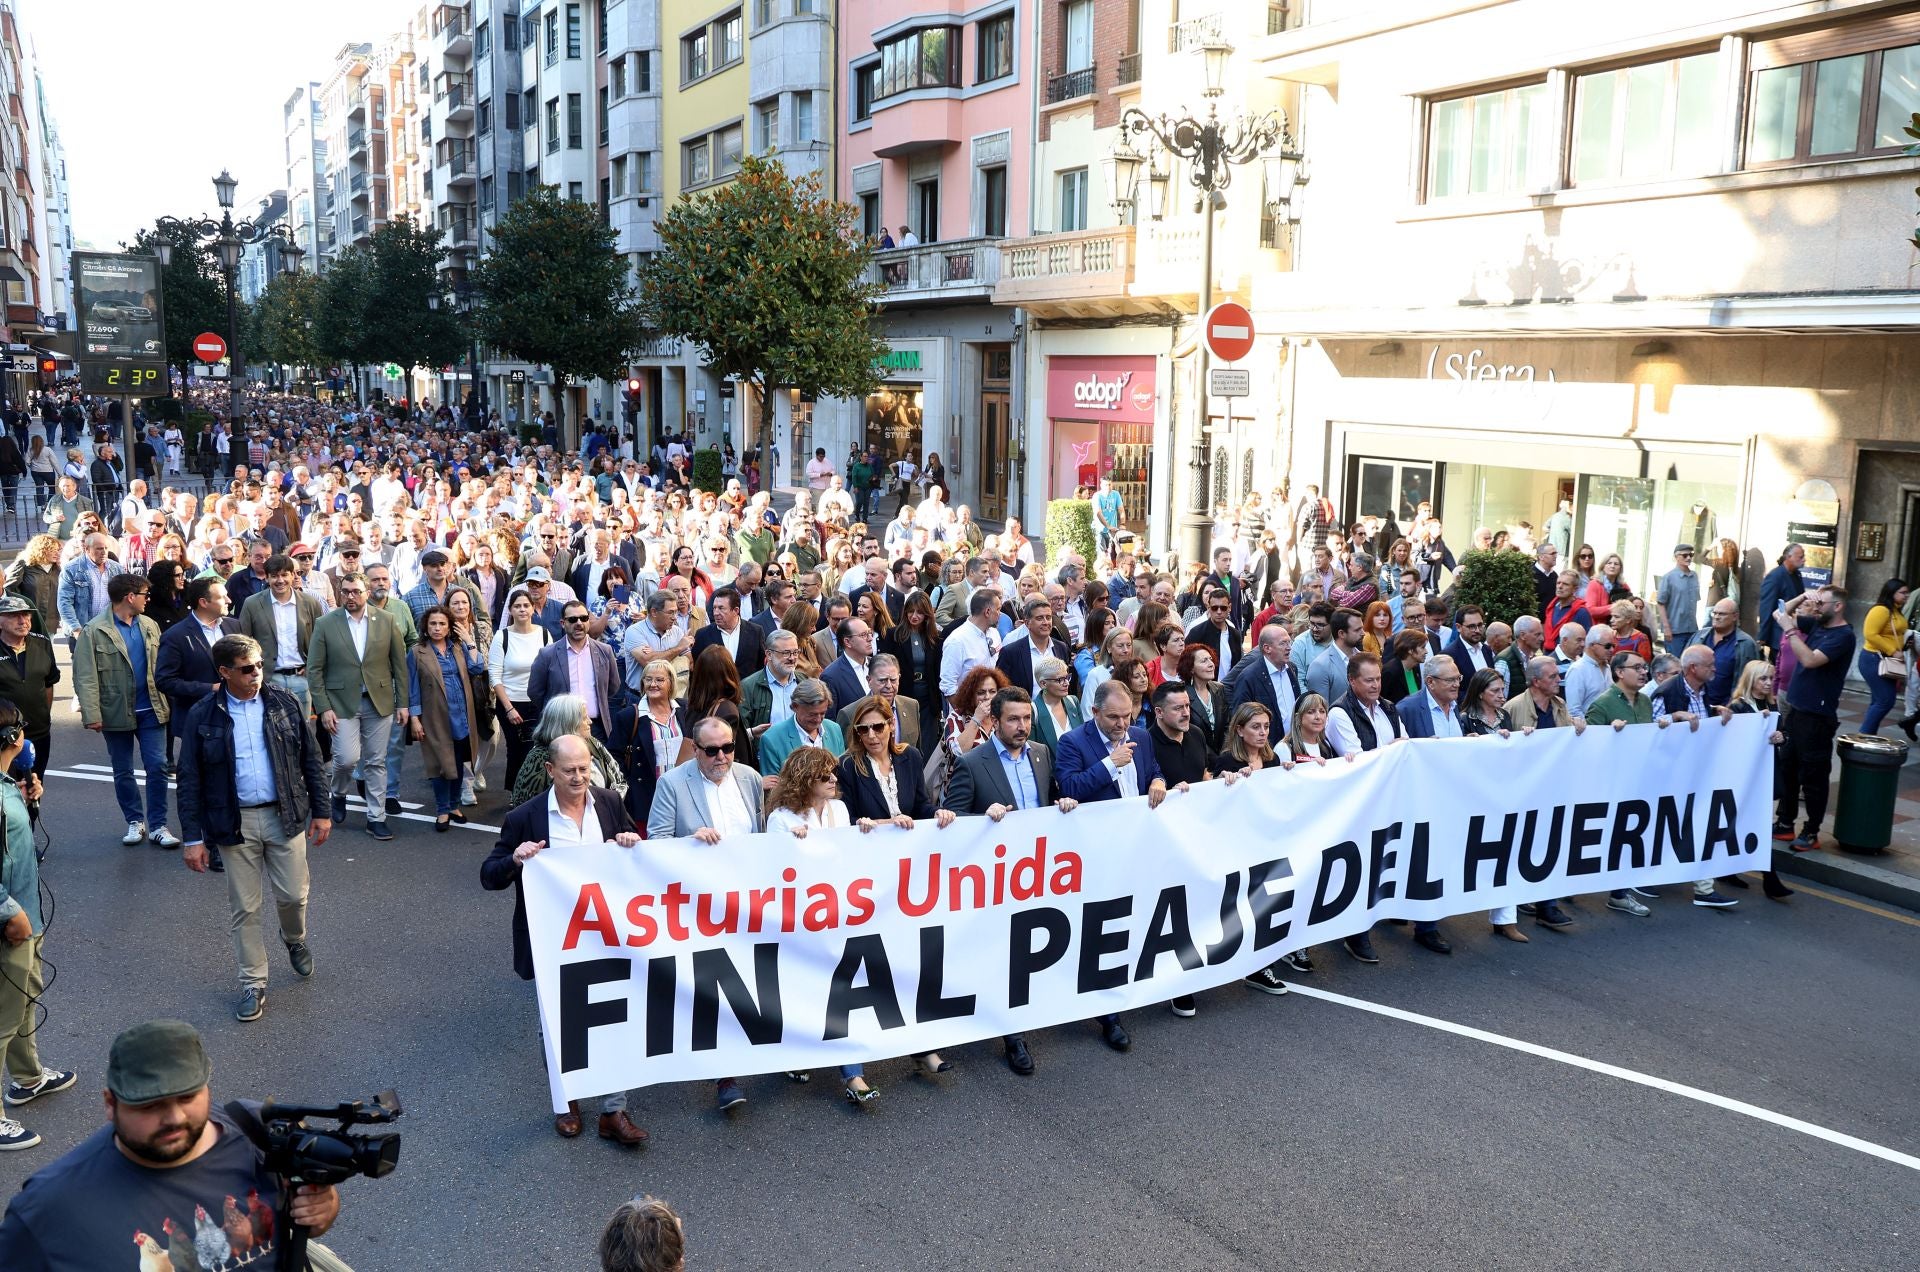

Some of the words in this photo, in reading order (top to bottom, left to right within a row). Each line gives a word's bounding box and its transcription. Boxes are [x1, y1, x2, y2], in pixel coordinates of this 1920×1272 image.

[559, 942, 783, 1074] FIN
[822, 925, 976, 1041] AL
[1008, 857, 1295, 1009] PEAJE
[1307, 821, 1444, 926] DEL
[1463, 789, 1758, 893] HUERNA.
[561, 867, 876, 951] Asturias
[897, 836, 1083, 918] Unida
